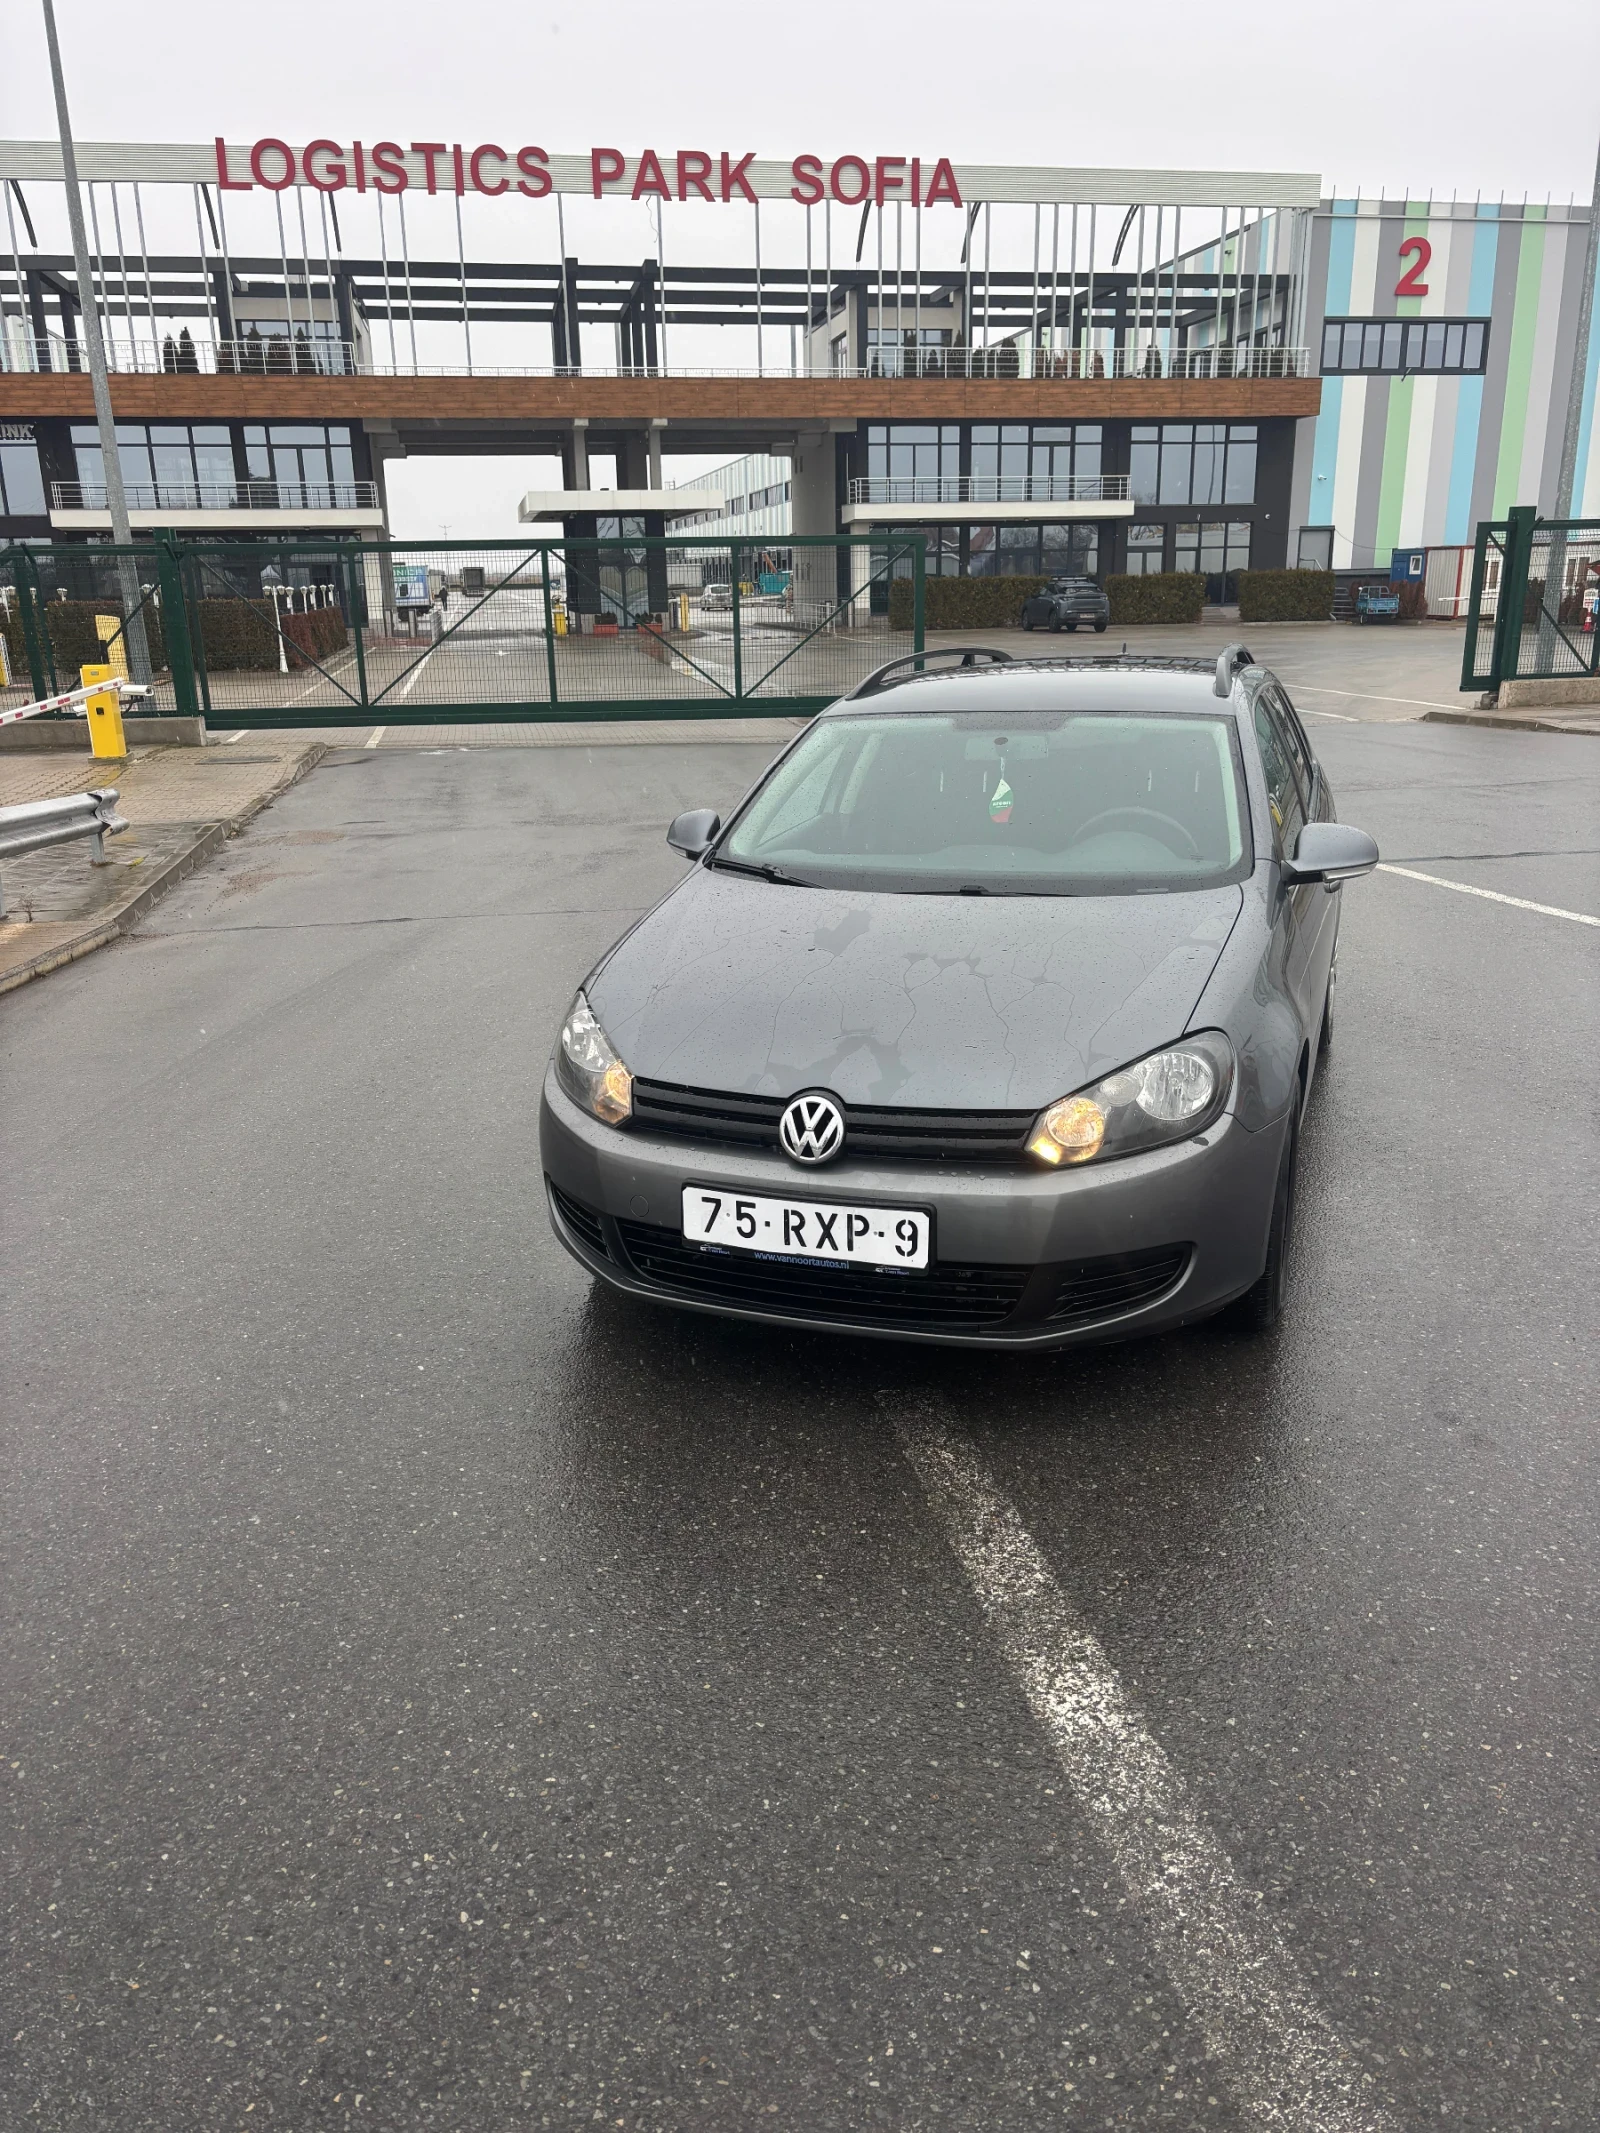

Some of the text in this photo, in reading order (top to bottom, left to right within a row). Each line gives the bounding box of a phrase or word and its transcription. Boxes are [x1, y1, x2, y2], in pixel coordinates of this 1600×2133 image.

[216, 138, 962, 207] LOGISTICS PARK SOFIA
[1395, 237, 1432, 295] 2
[0, 424, 35, 438] INK
[754, 1251, 850, 1270] www.vannoortautos.nl
